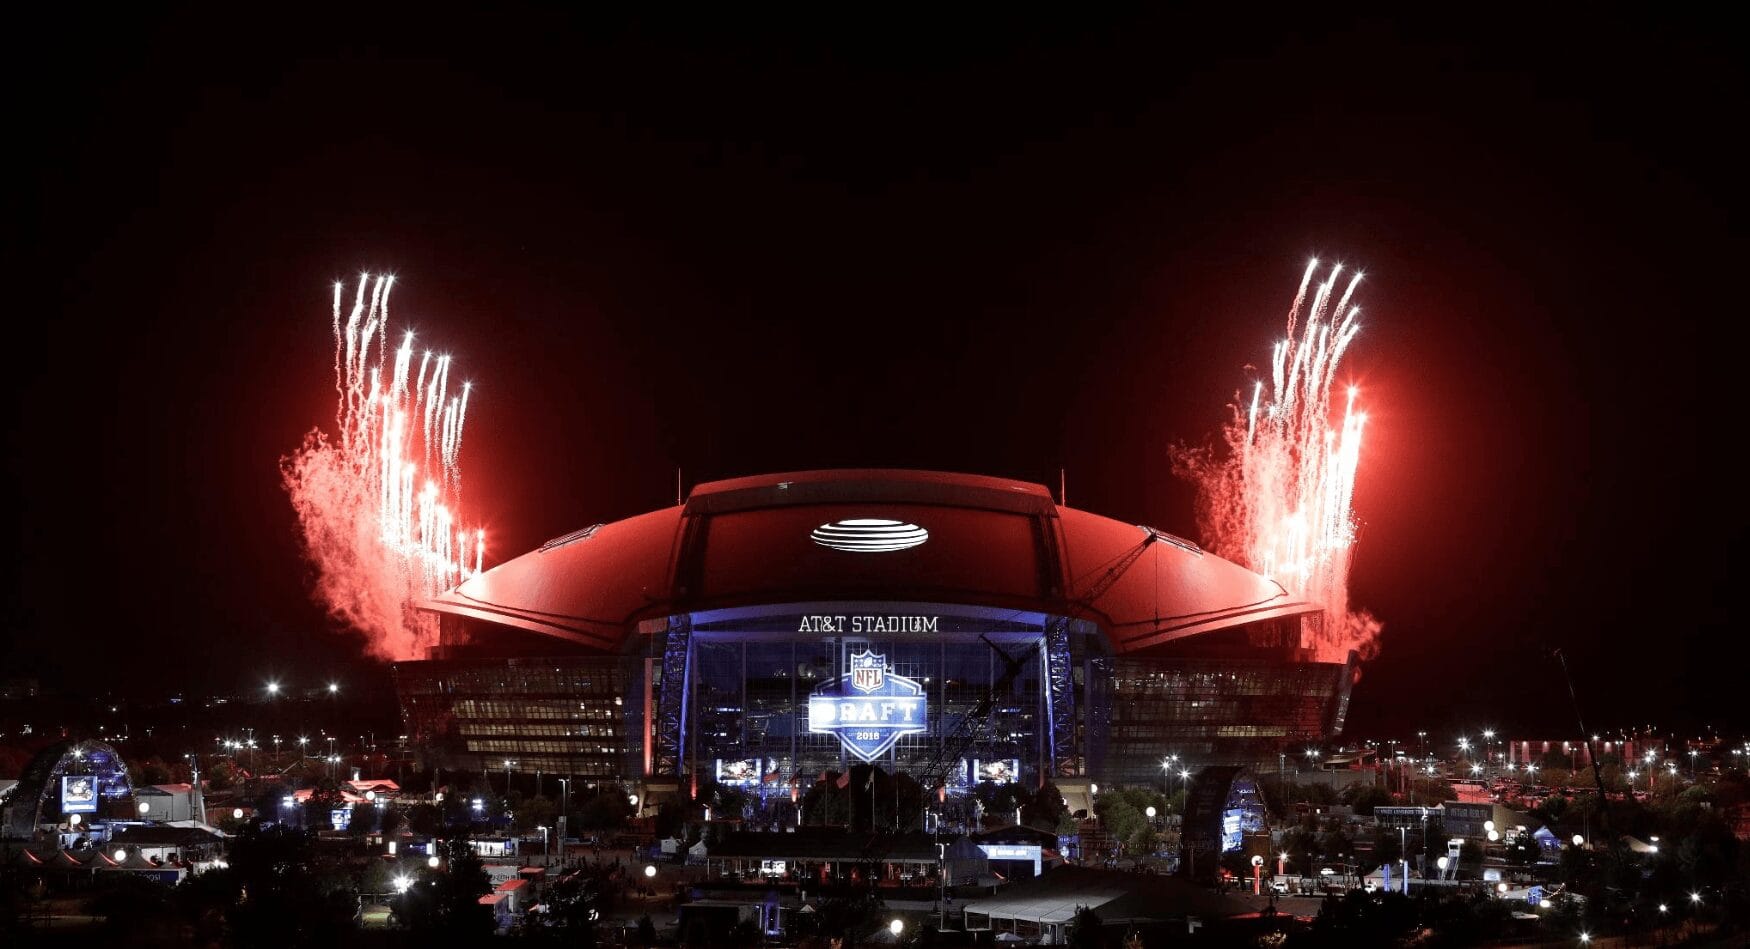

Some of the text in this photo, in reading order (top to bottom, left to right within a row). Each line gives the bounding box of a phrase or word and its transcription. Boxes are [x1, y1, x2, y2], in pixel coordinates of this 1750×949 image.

[798, 616, 939, 632] AT&T STADIUM
[856, 669, 881, 685] NFL
